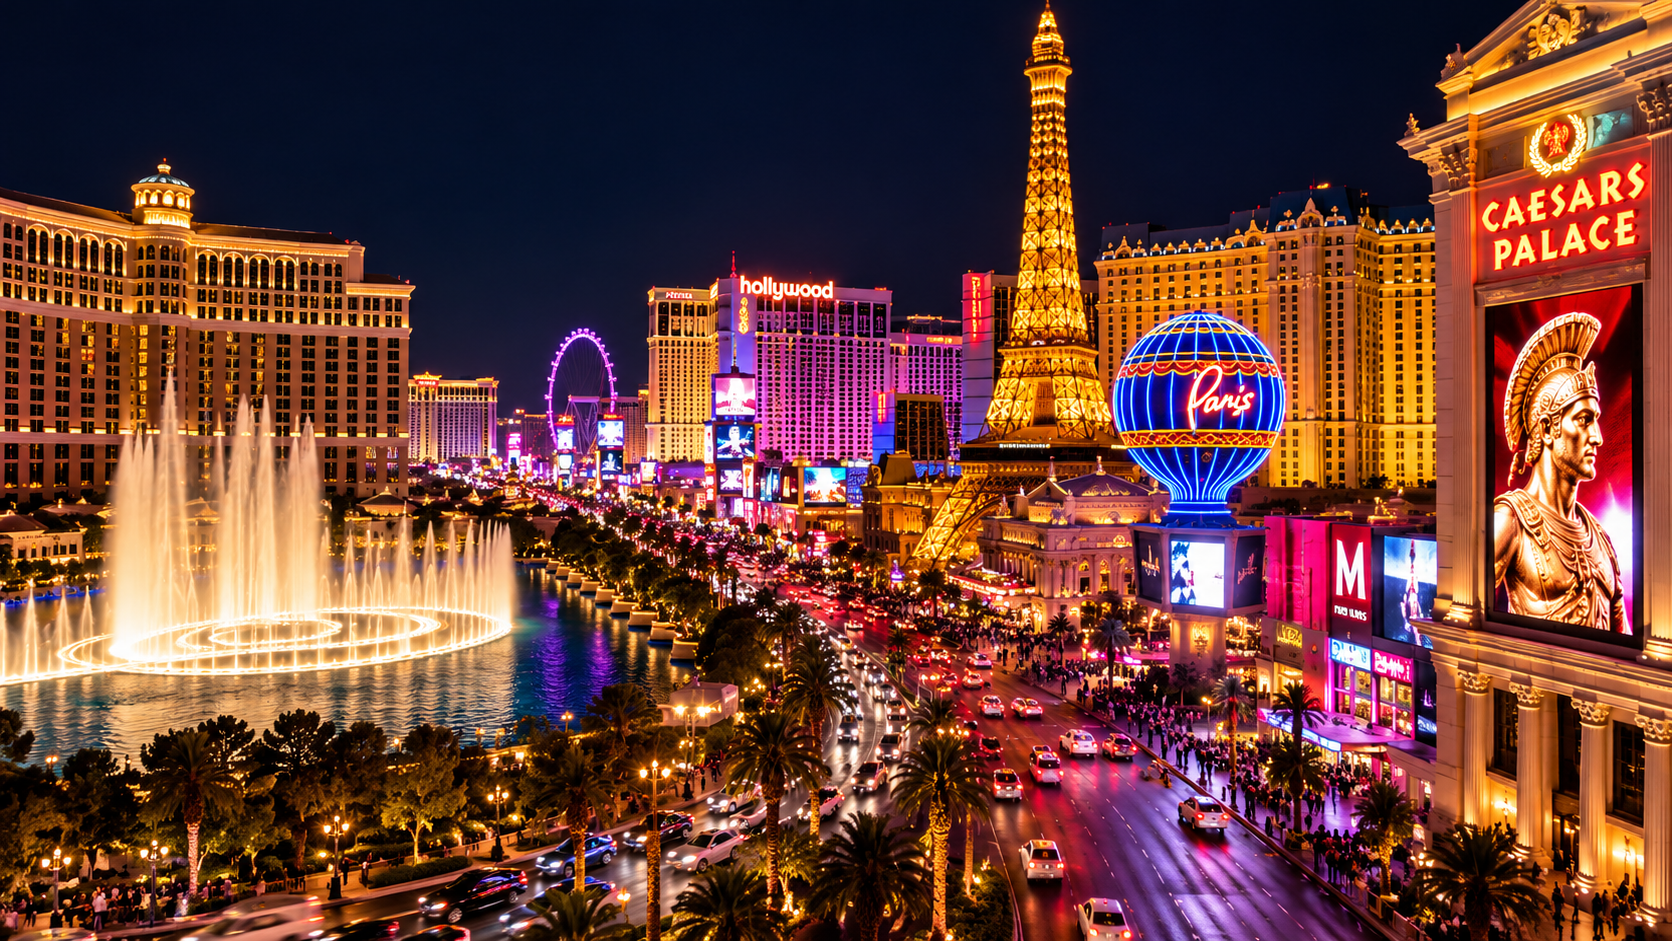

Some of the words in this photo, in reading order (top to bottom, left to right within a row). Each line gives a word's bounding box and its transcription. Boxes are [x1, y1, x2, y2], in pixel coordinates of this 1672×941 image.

[1482, 162, 1646, 232] CAESARS
[1494, 210, 1637, 270] PALACE
[740, 275, 834, 300] hollywood
[1187, 365, 1255, 431] Paris
[1335, 538, 1367, 600] M
